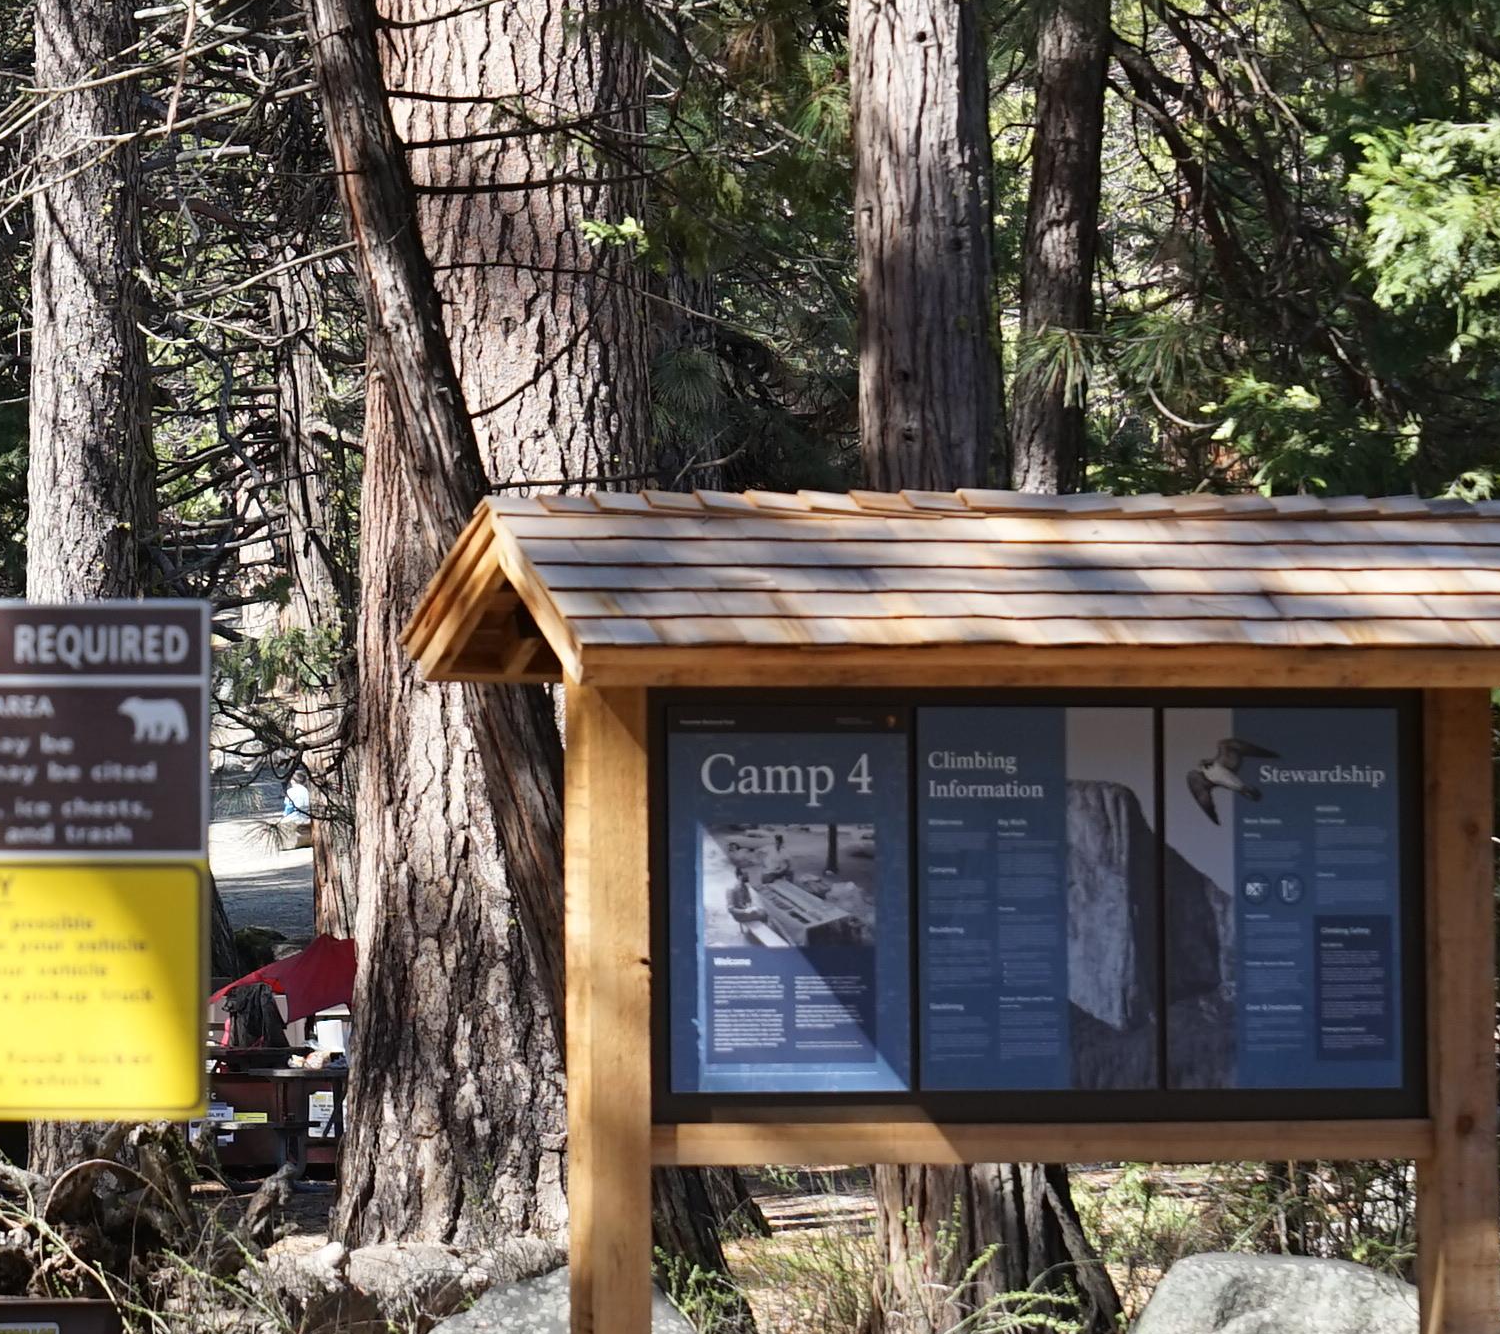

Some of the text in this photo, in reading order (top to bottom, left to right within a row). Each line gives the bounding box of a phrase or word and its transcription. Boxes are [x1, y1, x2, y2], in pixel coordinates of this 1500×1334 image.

[13, 623, 189, 669] REQUIRED
[40, 733, 74, 755] be
[47, 762, 82, 783] be
[90, 761, 157, 783] cited
[928, 751, 1017, 774] Climbing
[700, 753, 873, 806] Camp 4
[1259, 764, 1385, 787] Stewardship
[928, 779, 1044, 798] Information
[14, 797, 51, 819] ice
[60, 797, 153, 820] chests,
[5, 823, 55, 845] and
[64, 824, 133, 845] trash
